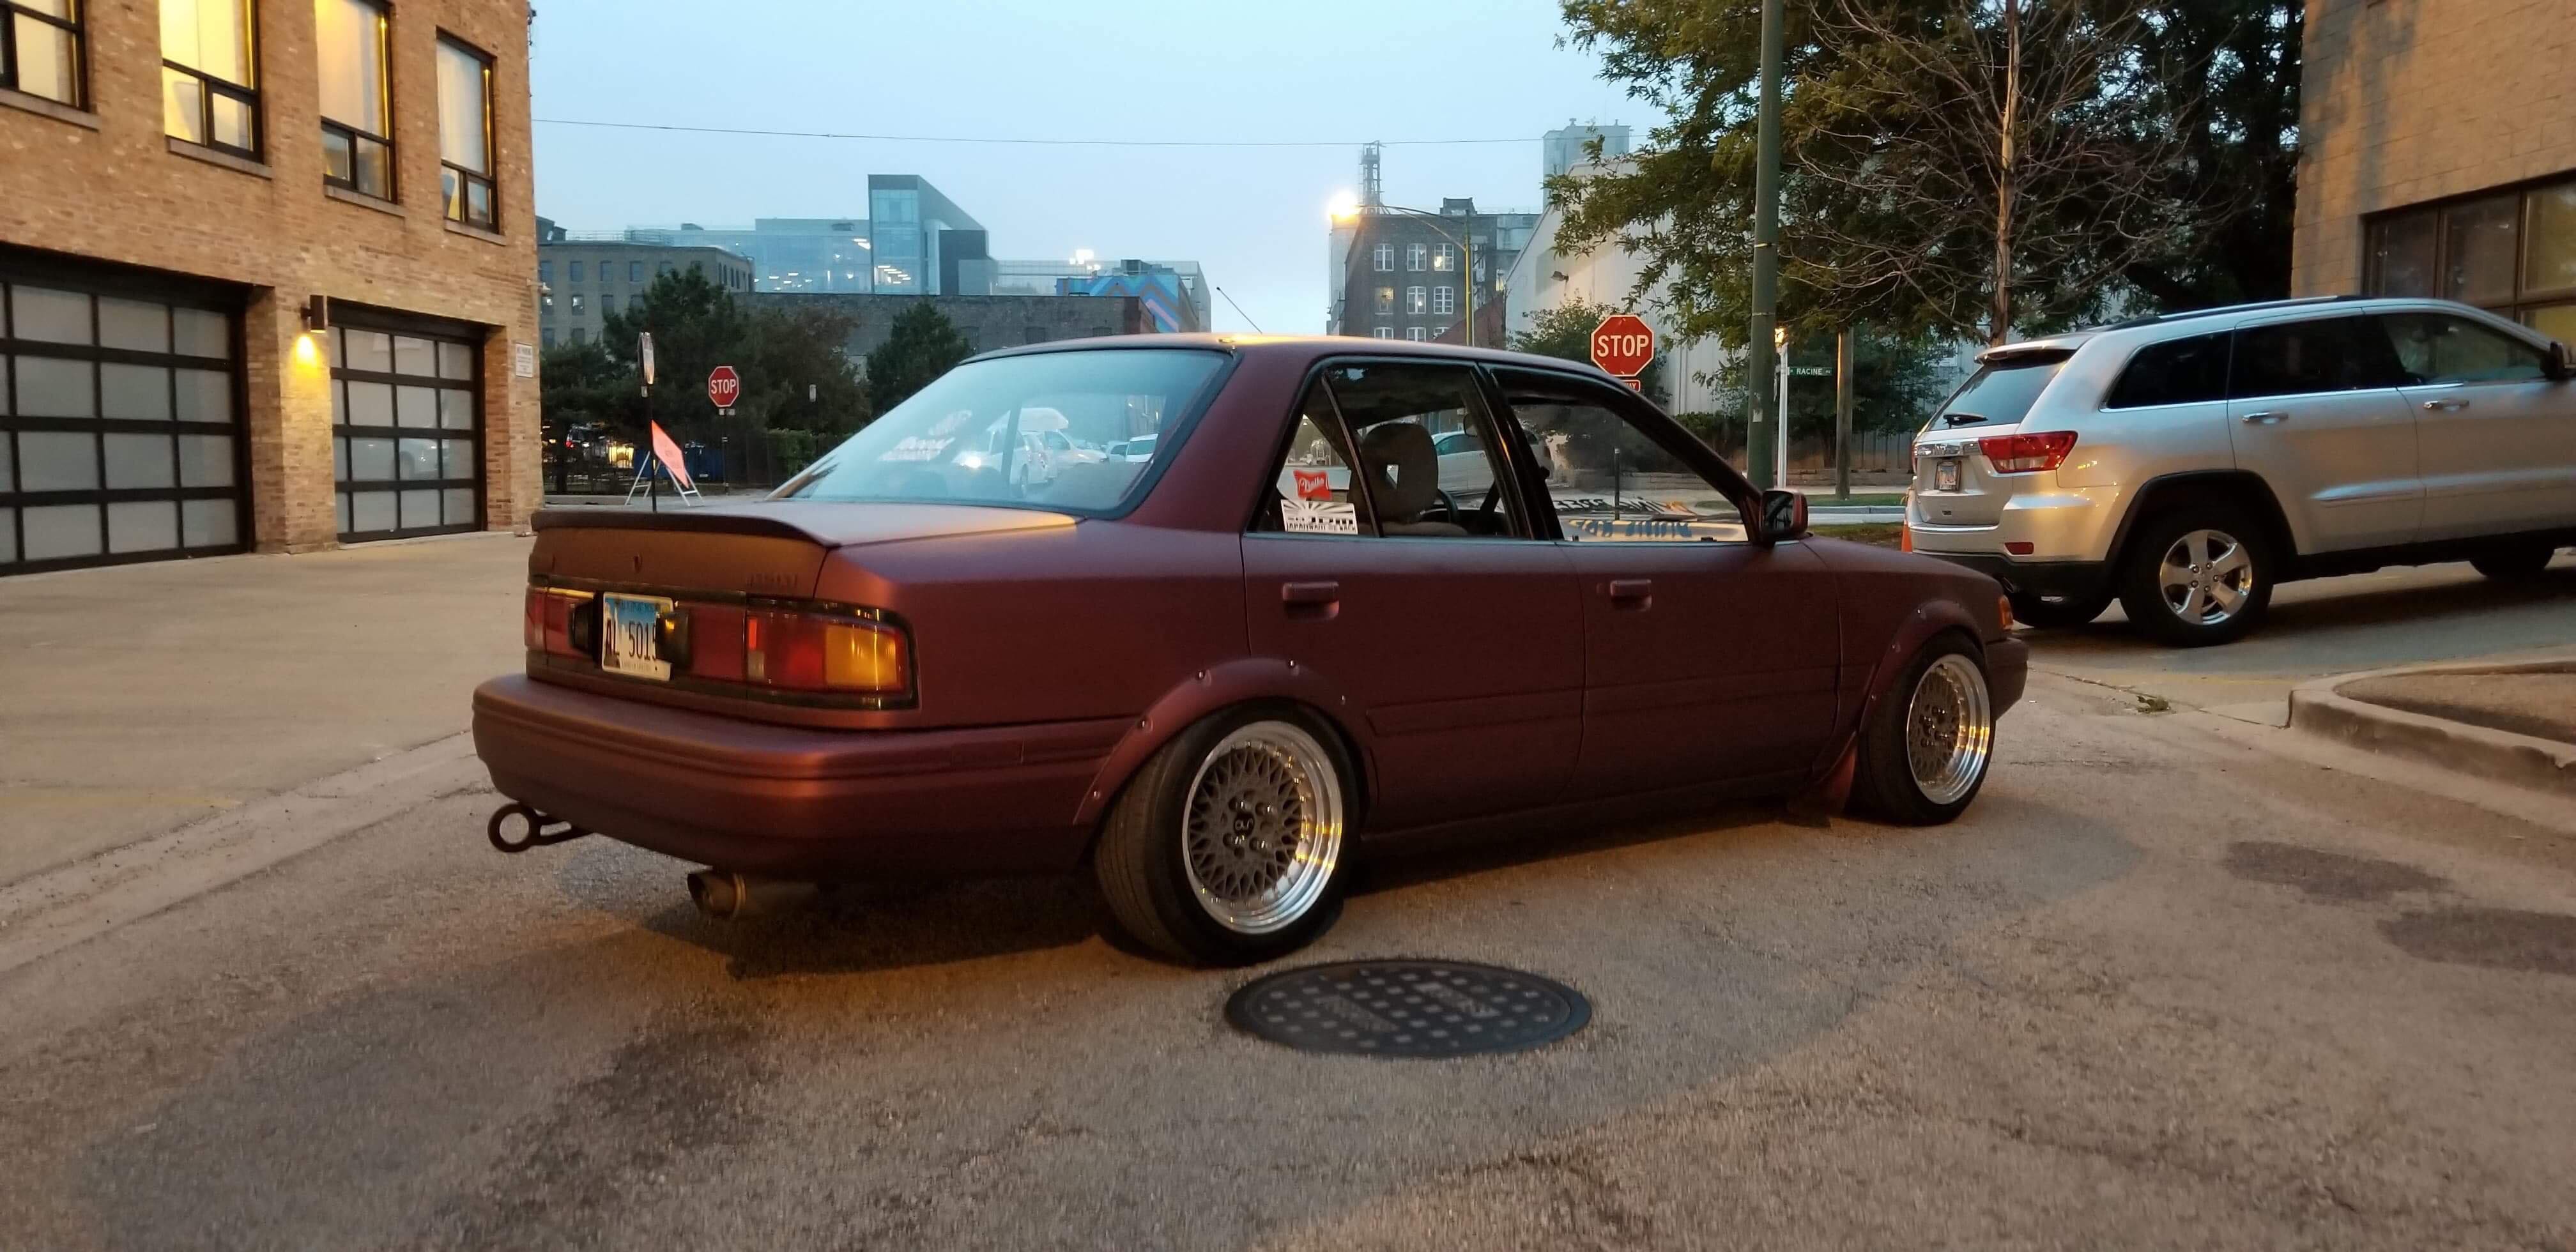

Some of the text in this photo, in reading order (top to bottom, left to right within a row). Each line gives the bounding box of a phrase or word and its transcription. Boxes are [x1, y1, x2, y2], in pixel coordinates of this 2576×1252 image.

[1597, 335, 1649, 357] STOP
[710, 379, 737, 394] STOP
[605, 618, 620, 656] AL
